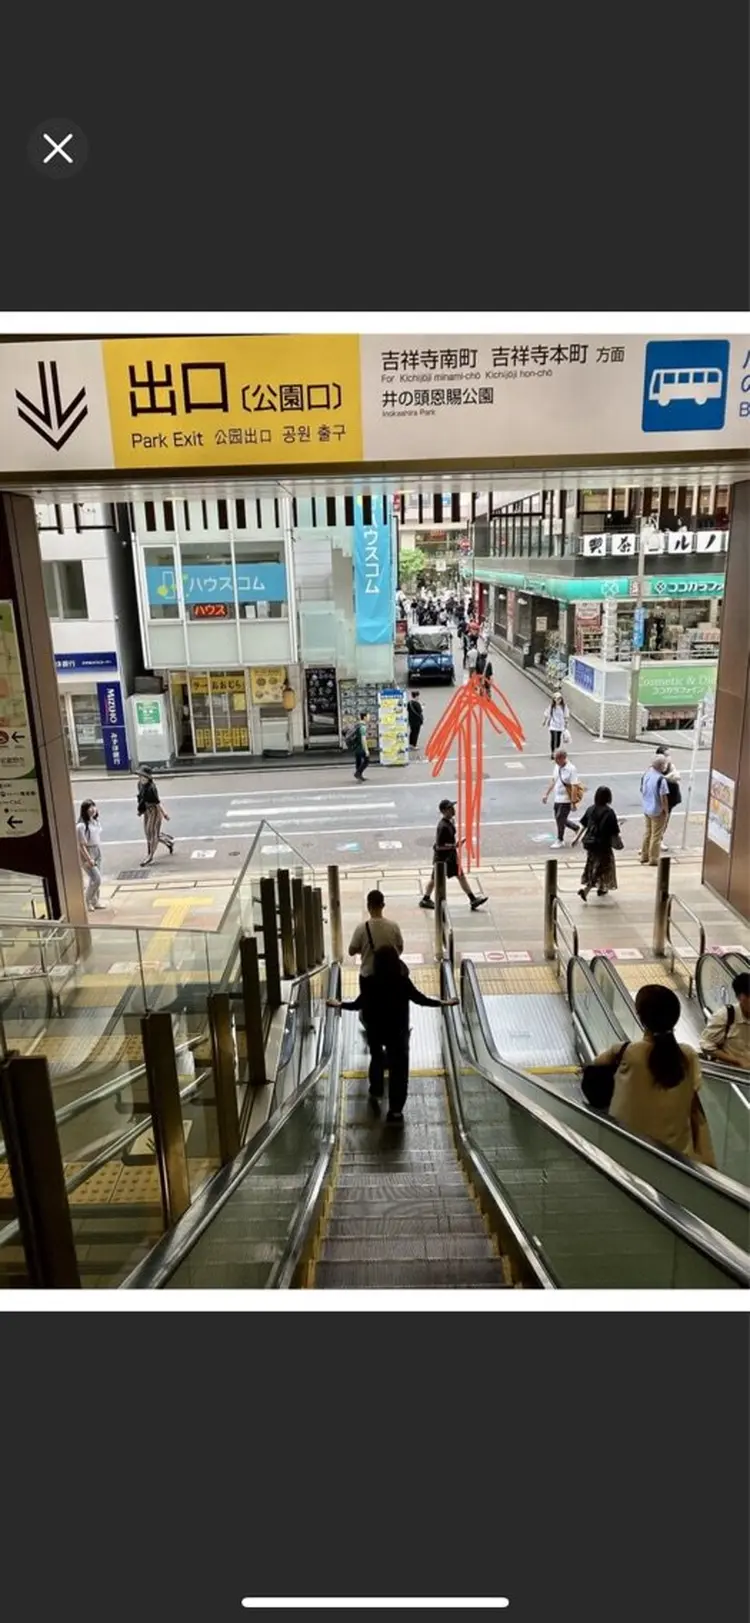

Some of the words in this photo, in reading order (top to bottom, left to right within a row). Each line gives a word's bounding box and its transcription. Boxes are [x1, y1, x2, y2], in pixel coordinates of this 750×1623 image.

[381, 348, 478, 371] 吉祥寺南町
[491, 343, 589, 368] 吉祥寺本町
[596, 346, 625, 363] 方面
[128, 361, 230, 416] 出口
[381, 374, 395, 383] For
[382, 387, 494, 407] 井の頭恩賜公園
[132, 433, 168, 449] Park
[173, 431, 204, 447] Exit
[282, 425, 311, 443] 공원
[317, 424, 347, 441] 출구
[588, 534, 716, 555] 喫茶ルノ
[188, 576, 266, 593] ハウスコム
[194, 605, 227, 616] ハウス
